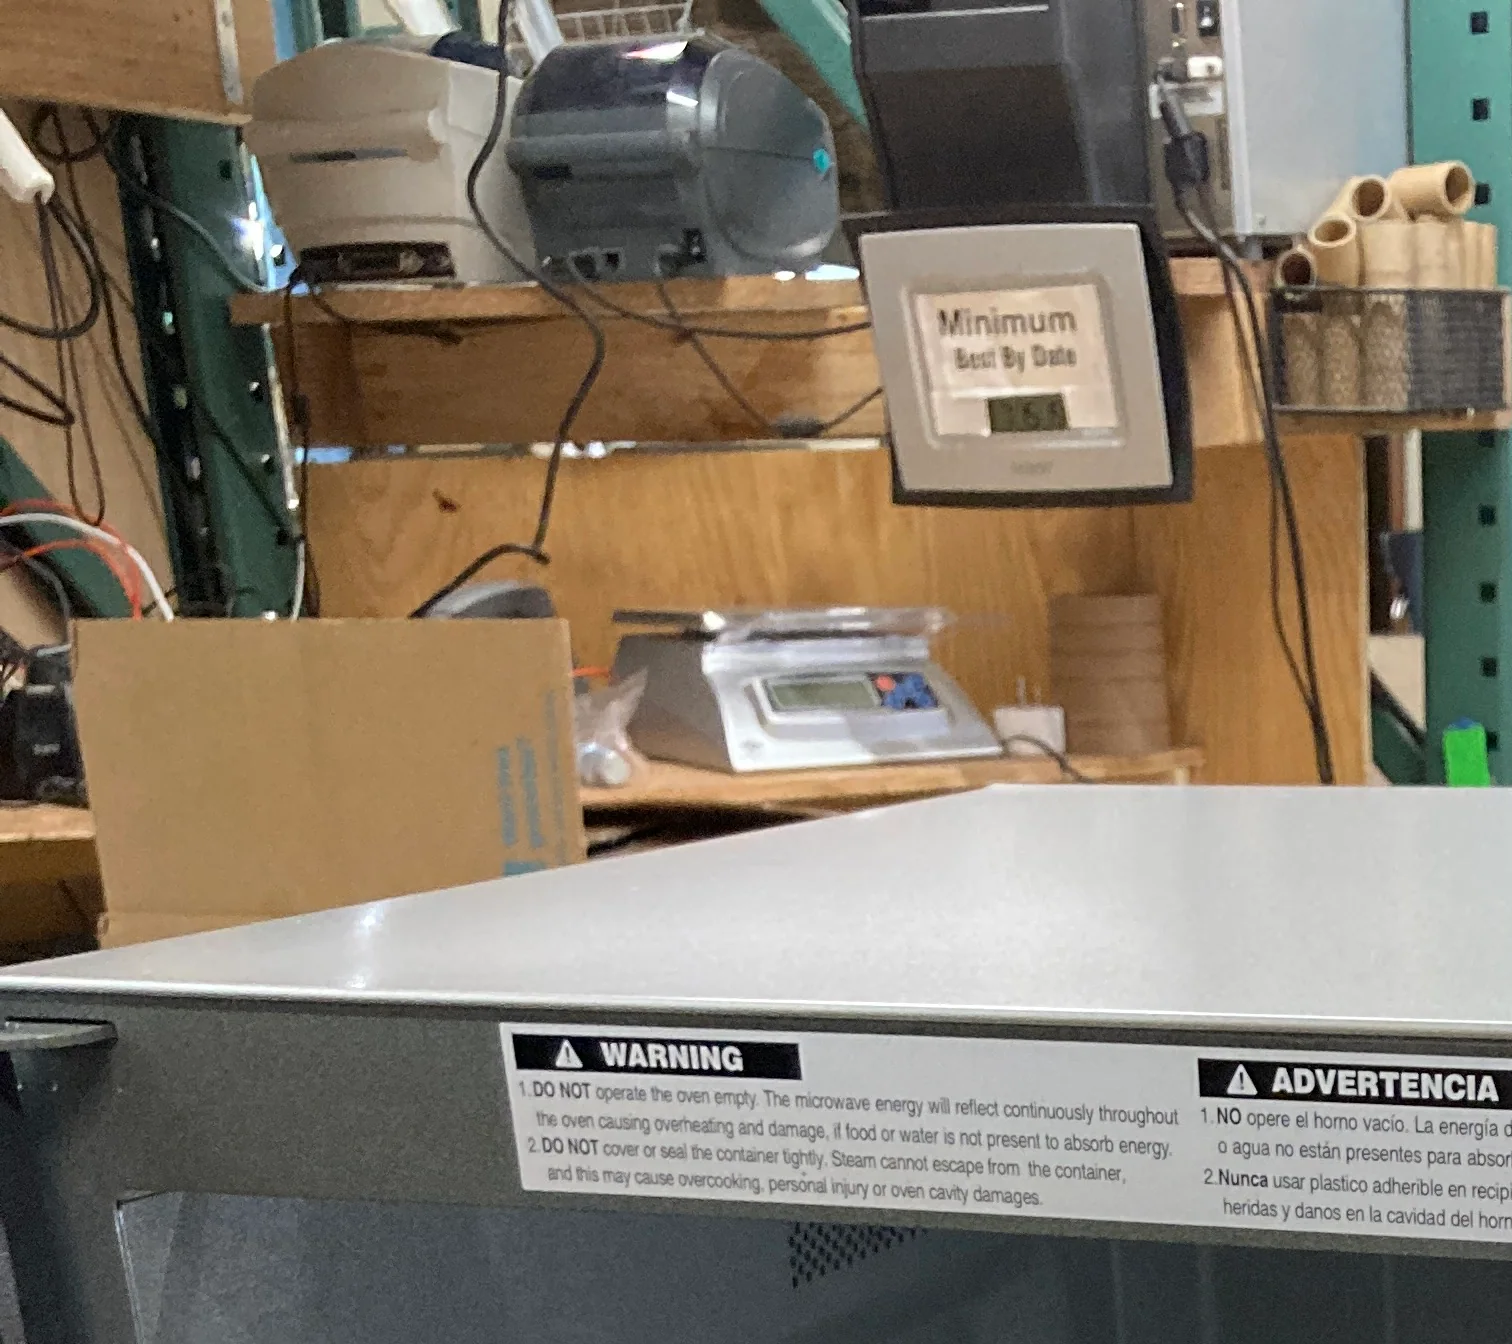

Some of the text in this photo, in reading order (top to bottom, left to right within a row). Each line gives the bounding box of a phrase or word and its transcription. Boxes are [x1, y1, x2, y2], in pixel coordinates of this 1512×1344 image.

[937, 308, 1078, 336] Minimum
[1031, 344, 1077, 367] Date
[600, 1042, 744, 1072] WARNING
[1272, 1067, 1500, 1102] ADVERTENCIA
[559, 1081, 591, 1100] NOT
[596, 1086, 647, 1104] operate
[650, 1086, 672, 1103] the
[677, 1090, 710, 1104] oven
[714, 1090, 759, 1110] empty.
[763, 1089, 790, 1108] The
[795, 1095, 870, 1112] microwave
[875, 1098, 923, 1118] energy
[928, 1097, 950, 1114] will
[955, 1098, 999, 1117] reflect
[1003, 1102, 1094, 1126] continuously
[1099, 1104, 1179, 1129] throughout
[536, 1112, 1172, 1160] the oven causing overheating and damage, if food or water is not present to absorb energy.
[1247, 1112, 1290, 1130] opere
[1296, 1111, 1308, 1129] el
[1314, 1111, 1358, 1131] horno
[1363, 1114, 1408, 1133] vacío.
[1415, 1115, 1434, 1135] La
[1439, 1118, 1498, 1141] energía
[568, 1138, 599, 1156] NOT
[603, 1143, 639, 1157] cover
[643, 1145, 656, 1158] or
[660, 1143, 687, 1159] seal
[691, 1144, 712, 1161] the
[716, 1147, 779, 1164] container
[783, 1149, 827, 1170] tightly.
[831, 1150, 876, 1168] Steam
[880, 1156, 928, 1171] cannot
[932, 1159, 984, 1178] escape
[988, 1158, 1020, 1176] from
[1028, 1160, 1051, 1178] the
[1055, 1163, 1126, 1184] container,
[1218, 1141, 1227, 1154] o
[1233, 1141, 1270, 1160] agua
[1275, 1143, 1294, 1157] no
[1299, 1141, 1341, 1159] están
[1346, 1146, 1422, 1165] presentes
[1427, 1150, 1461, 1168] para
[548, 1166, 1042, 1209] and this may cause overcooking, personal injury or oven cavity damages.
[1273, 1175, 1305, 1190] usar
[1310, 1174, 1368, 1195] plastico
[1373, 1176, 1443, 1197] adherible
[1448, 1184, 1466, 1198] en
[1223, 1198, 1278, 1217] heridas
[1282, 1205, 1290, 1223] y
[1295, 1202, 1341, 1221] danos
[1346, 1208, 1364, 1222] en
[1369, 1205, 1382, 1223] la
[1387, 1207, 1445, 1227] cavidad
[1451, 1210, 1473, 1228] del
